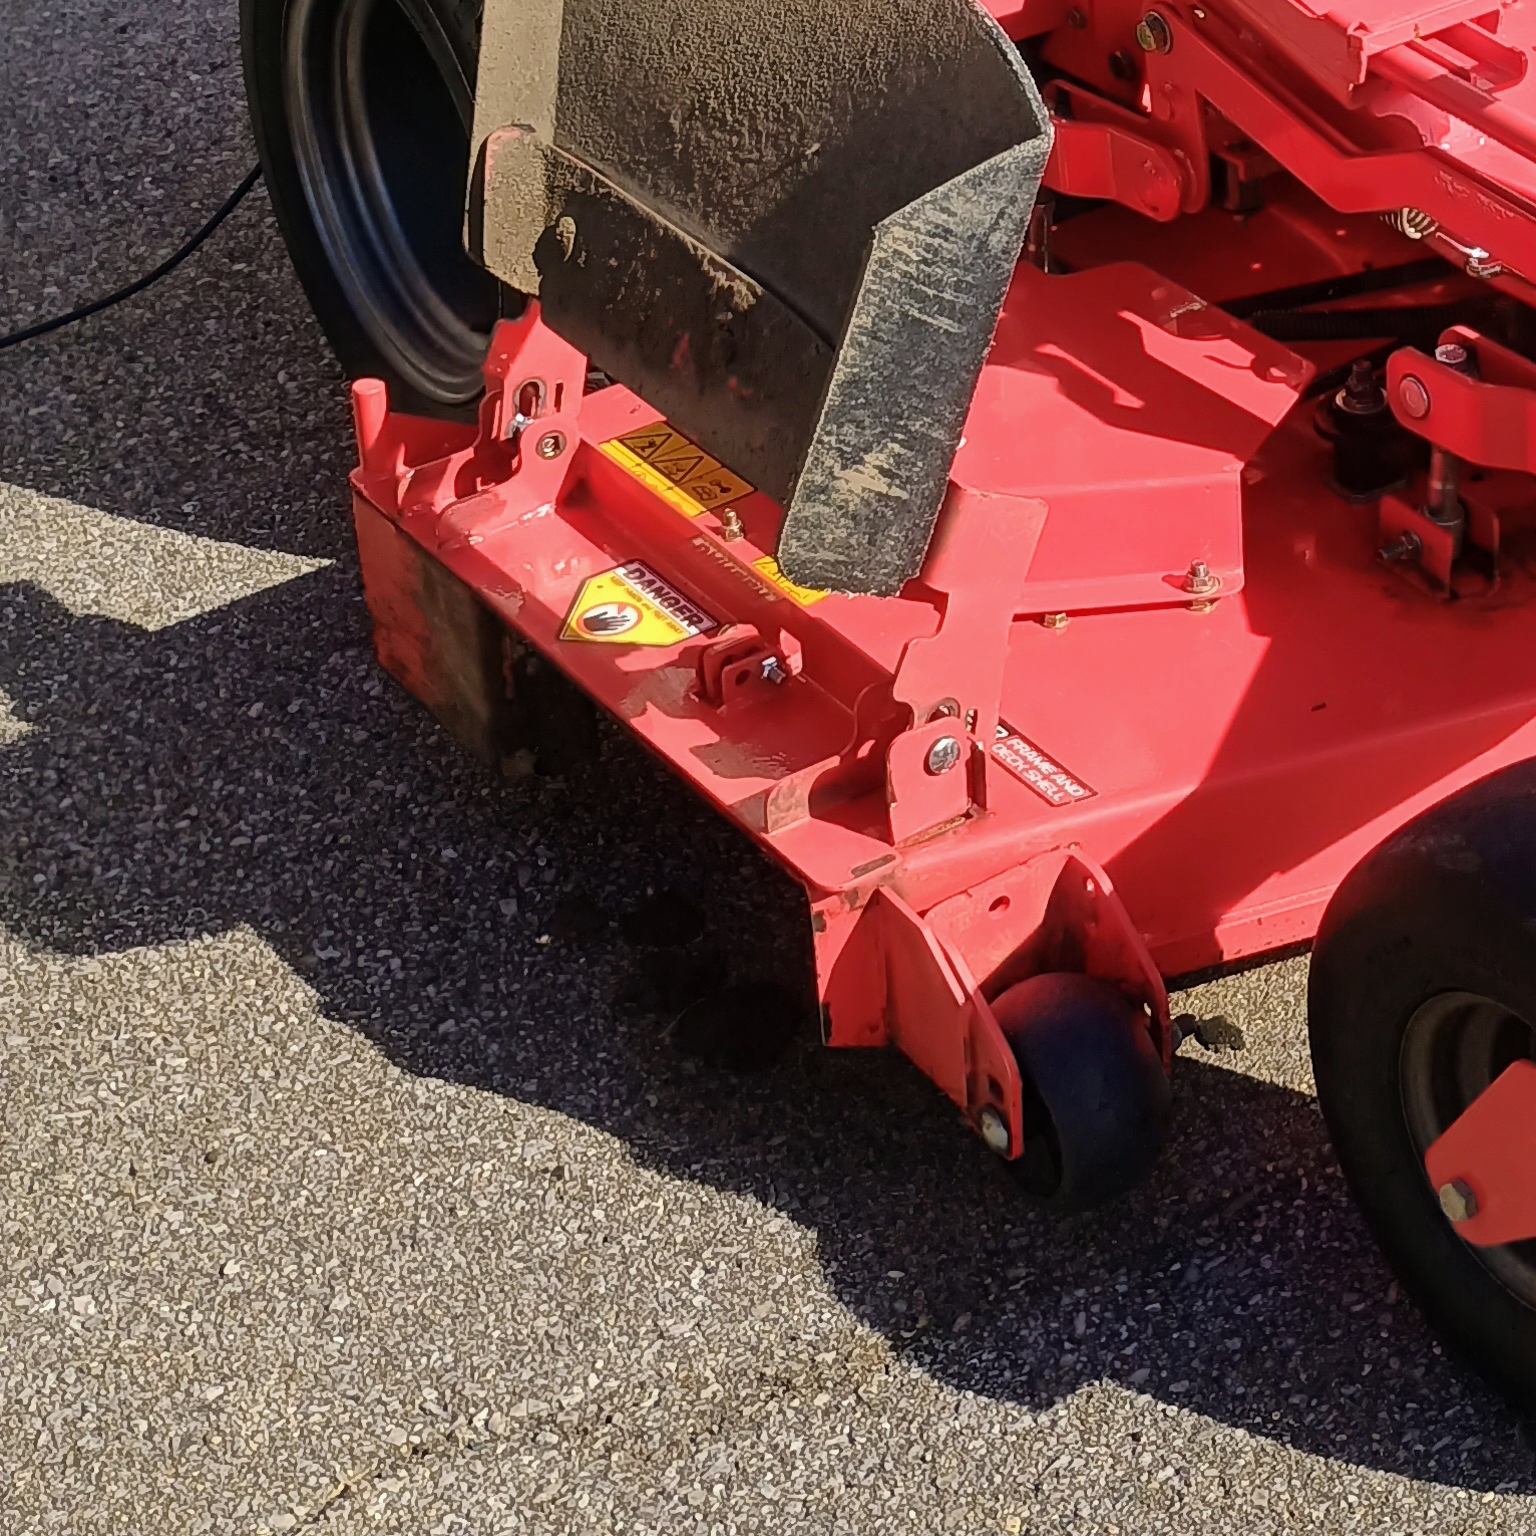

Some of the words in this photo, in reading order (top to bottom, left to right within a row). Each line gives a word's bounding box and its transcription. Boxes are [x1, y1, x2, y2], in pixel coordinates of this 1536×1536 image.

[623, 567, 704, 628] DANGER
[1006, 737, 1058, 775] FRAME
[1050, 773, 1086, 798] AND
[1022, 769, 1065, 802] SHELL
